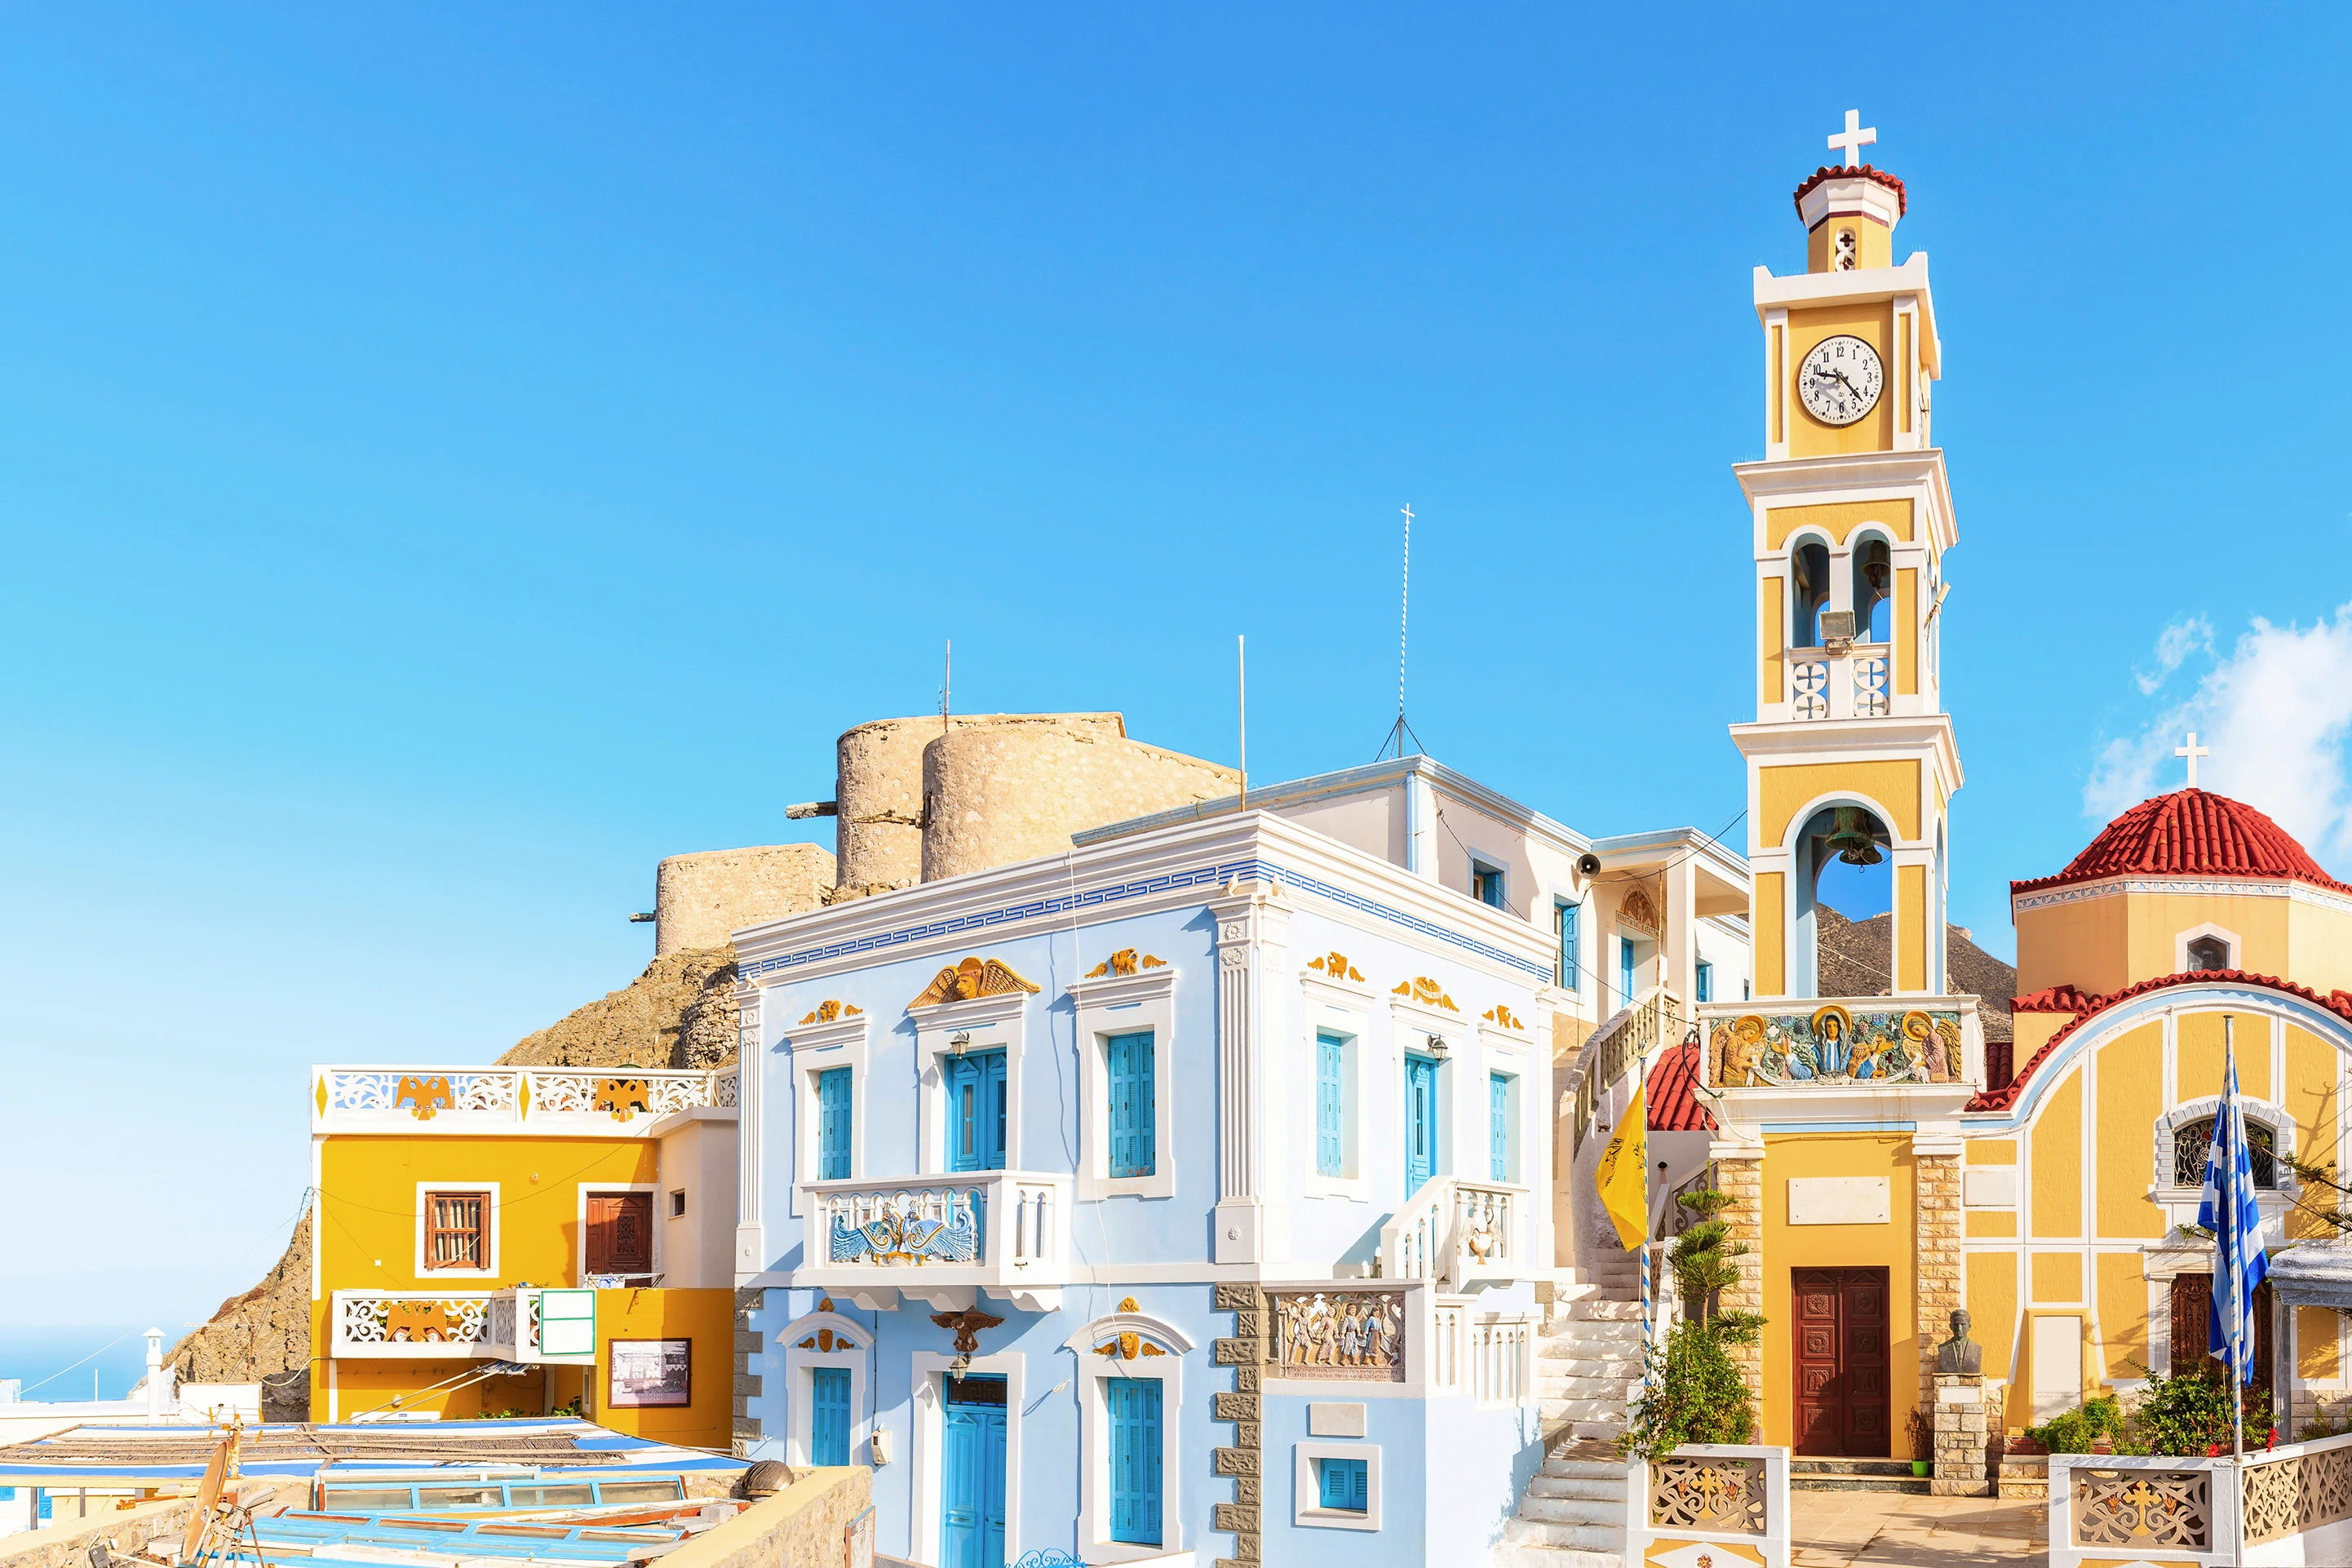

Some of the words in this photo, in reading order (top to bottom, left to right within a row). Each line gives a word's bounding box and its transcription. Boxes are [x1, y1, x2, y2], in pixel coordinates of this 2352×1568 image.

[1836, 346, 1845, 357] 12
[1852, 348, 1856, 360] 1
[1823, 352, 1829, 363] 11
[1813, 363, 1821, 375] 10
[1863, 359, 1868, 370] 2
[1867, 371, 1872, 383] 3
[1809, 378, 1815, 389] 9
[1814, 390, 1819, 401] 8
[1863, 385, 1868, 396] 4
[1825, 401, 1831, 412] 7
[1839, 402, 1845, 414] 6
[1851, 398, 1857, 410] 5
